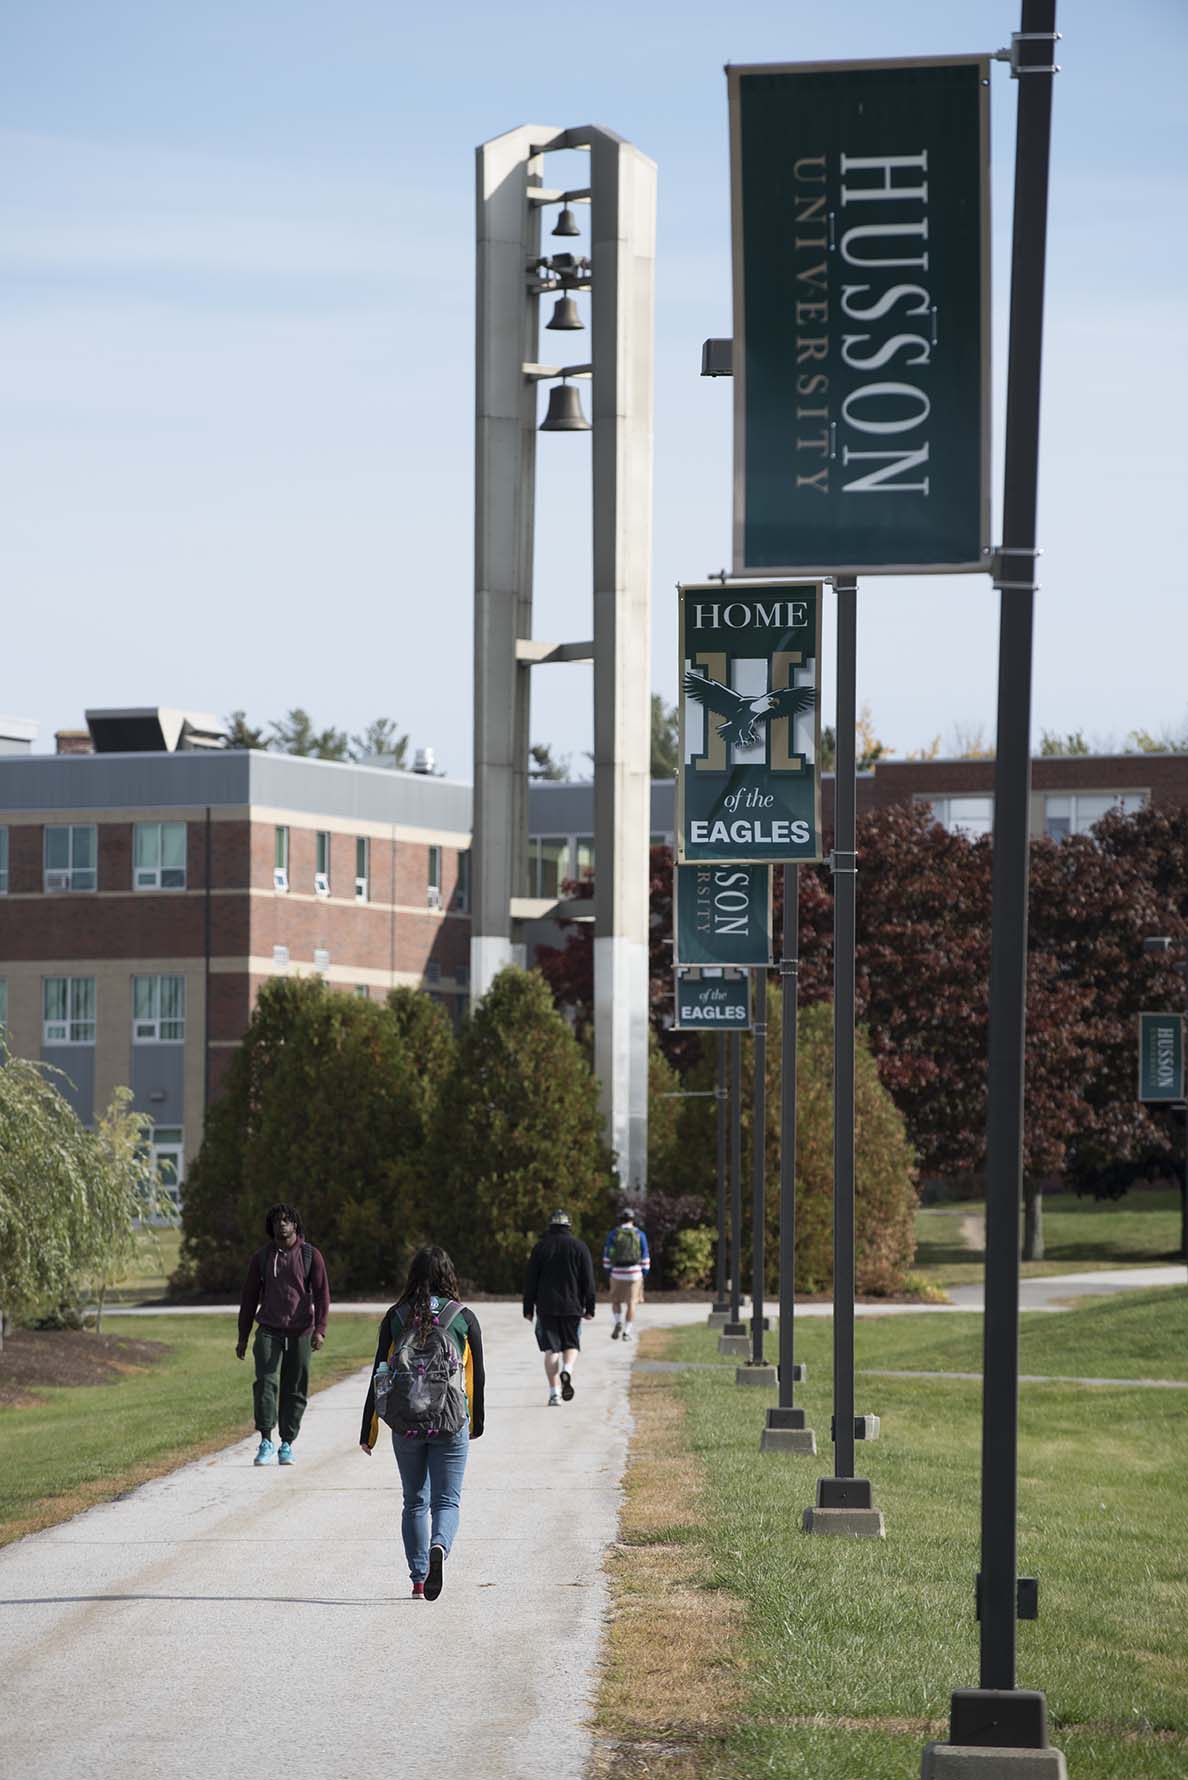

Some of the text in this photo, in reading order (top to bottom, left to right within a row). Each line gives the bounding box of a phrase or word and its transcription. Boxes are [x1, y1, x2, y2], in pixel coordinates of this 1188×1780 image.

[793, 154, 830, 493] UNIVERSITY
[840, 149, 931, 496] HUSSON
[693, 602, 808, 629] HOME
[723, 787, 774, 813] of the
[691, 820, 810, 843] EAGLES
[697, 865, 711, 934] RSITY
[715, 865, 749, 936] SON
[681, 1005, 747, 1020] EAGLES
[699, 988, 727, 1004] of the
[1157, 1028, 1174, 1088] HUSSON
